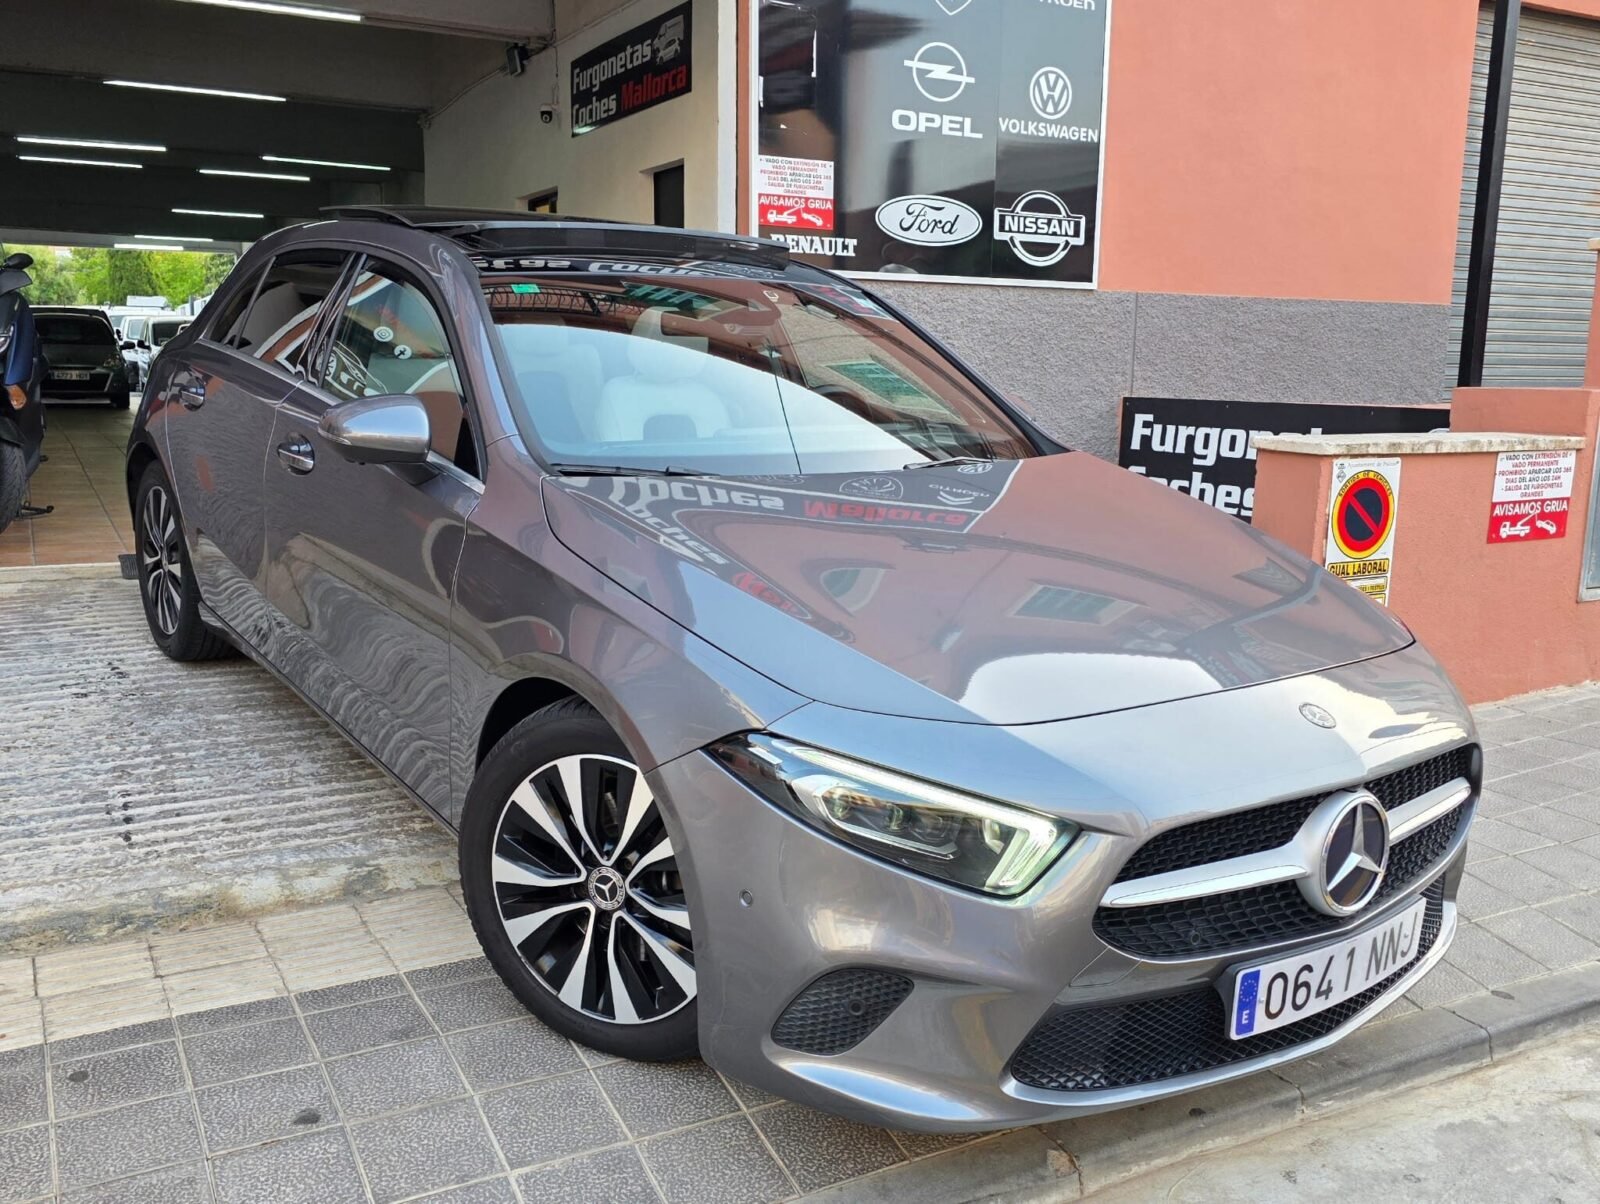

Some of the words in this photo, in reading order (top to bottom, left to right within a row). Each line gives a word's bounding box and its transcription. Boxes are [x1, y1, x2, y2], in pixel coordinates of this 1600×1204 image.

[573, 39, 652, 94] Furgonetas
[572, 94, 617, 128] Coches
[620, 64, 687, 113] Mallorca
[891, 108, 984, 139] OPEL
[998, 116, 1099, 143] VOLKSWAGEN
[759, 195, 806, 208] AVISAMOS
[807, 199, 833, 210] GRUA
[899, 202, 960, 236] Ford
[1004, 215, 1075, 236] NISSAN
[1130, 413, 1323, 467] Furgo
[1498, 469, 1527, 477] PROHIBIDO
[1531, 482, 1563, 490] FURGONETAS
[1493, 501, 1542, 517] AVISAMOS
[1543, 500, 1569, 513] GRUA
[1330, 563, 1350, 577] GUAL
[1352, 561, 1387, 575] LABORAL
[1264, 946, 1357, 1021] 0641
[1365, 911, 1418, 982] NNJ
[1242, 1009, 1250, 1024] E
